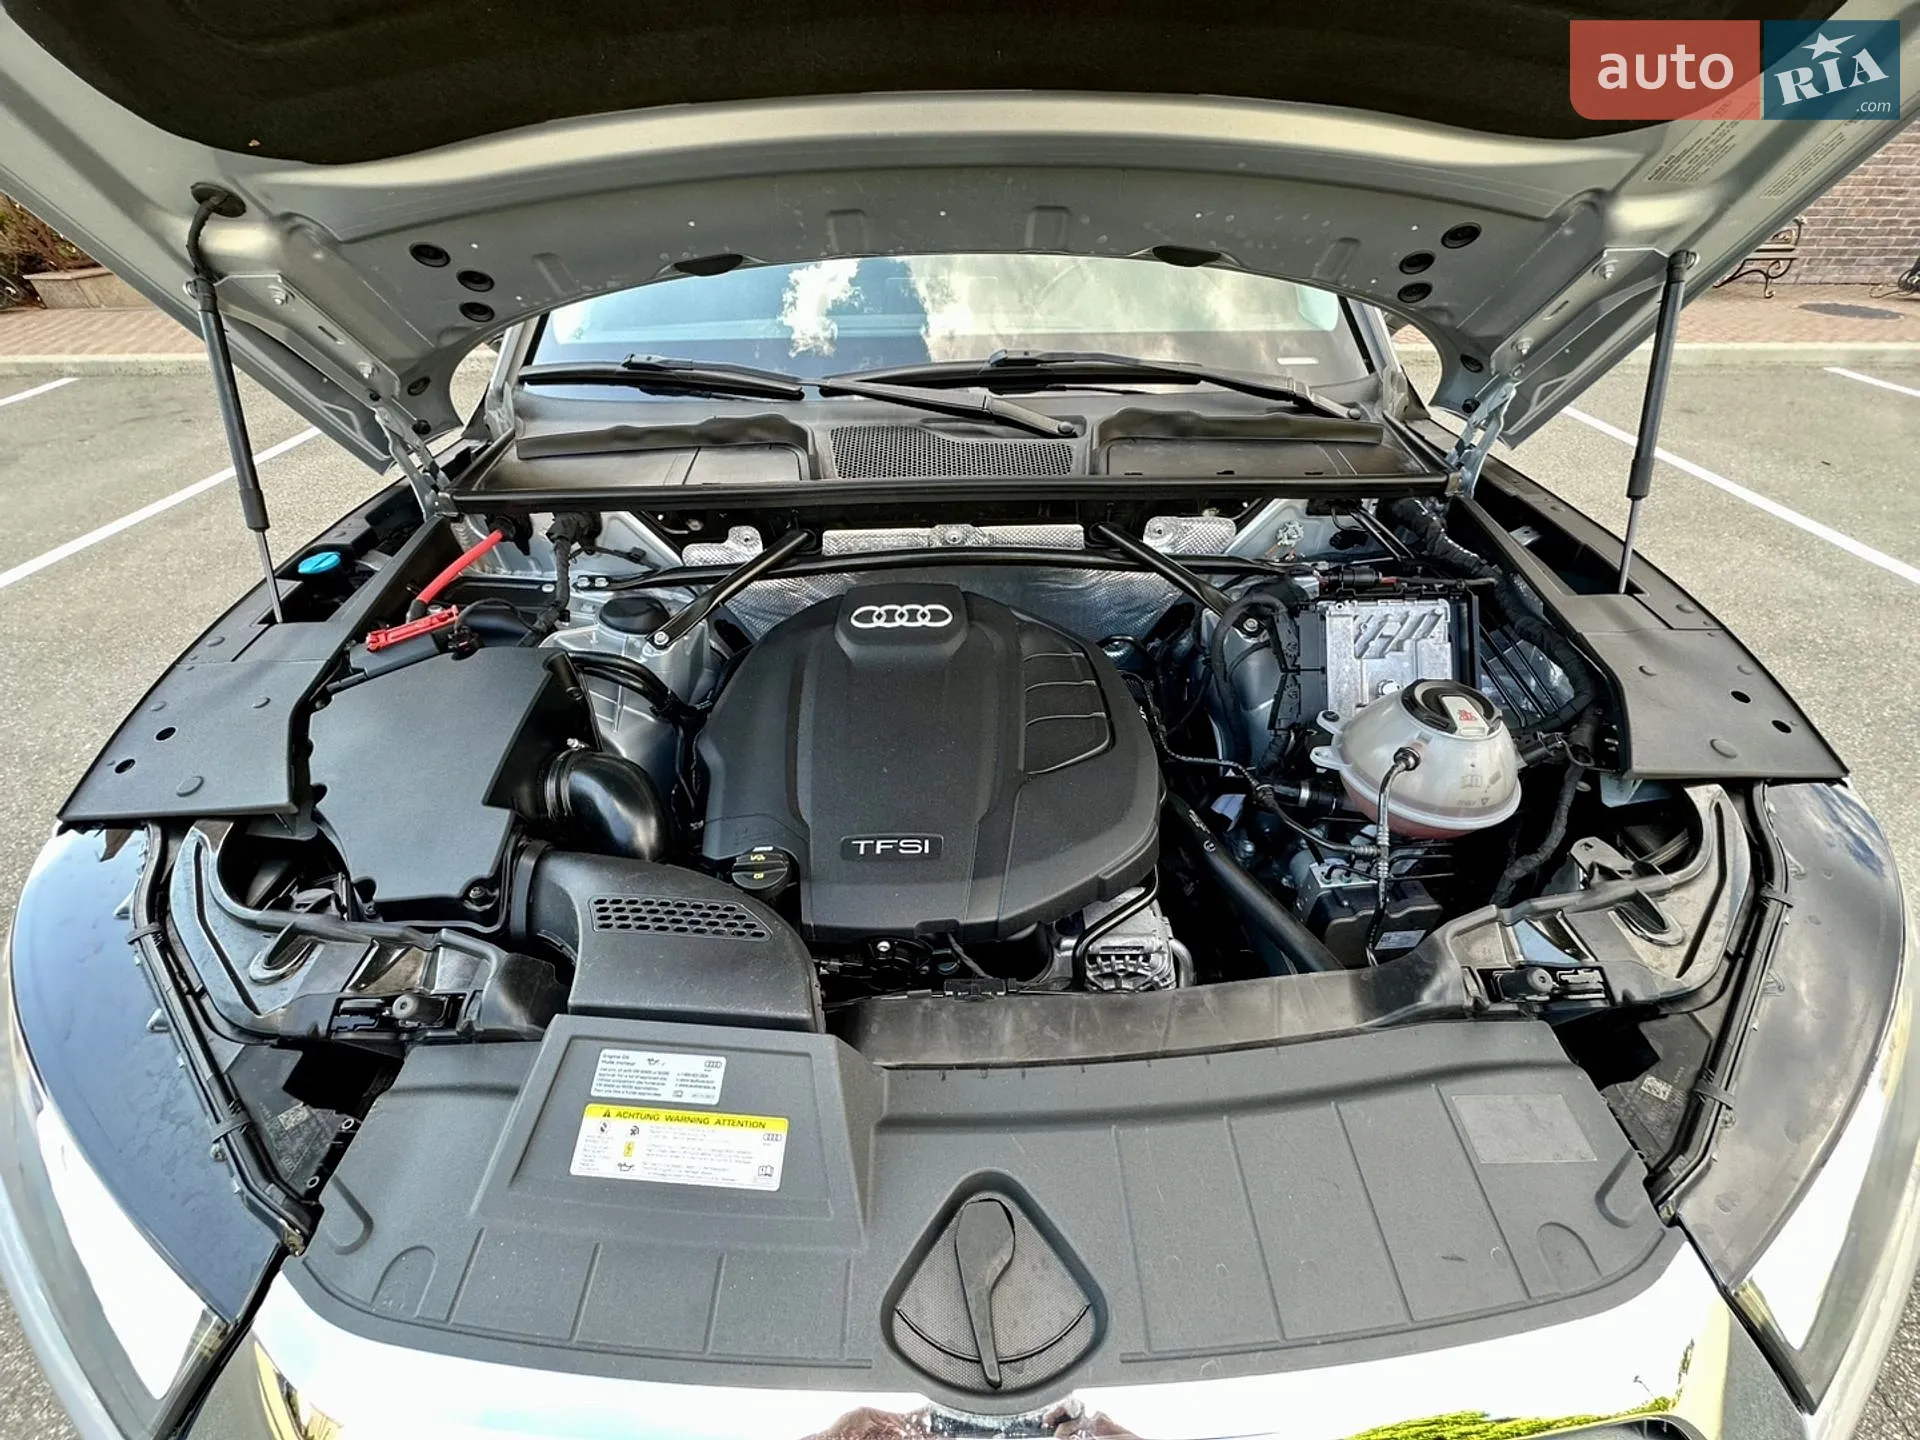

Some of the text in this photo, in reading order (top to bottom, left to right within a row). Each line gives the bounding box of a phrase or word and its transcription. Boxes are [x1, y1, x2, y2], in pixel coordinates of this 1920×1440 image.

[852, 839, 929, 855] TFSI
[615, 1110, 767, 1129] ACHTUNG WARNING ATTENTION
